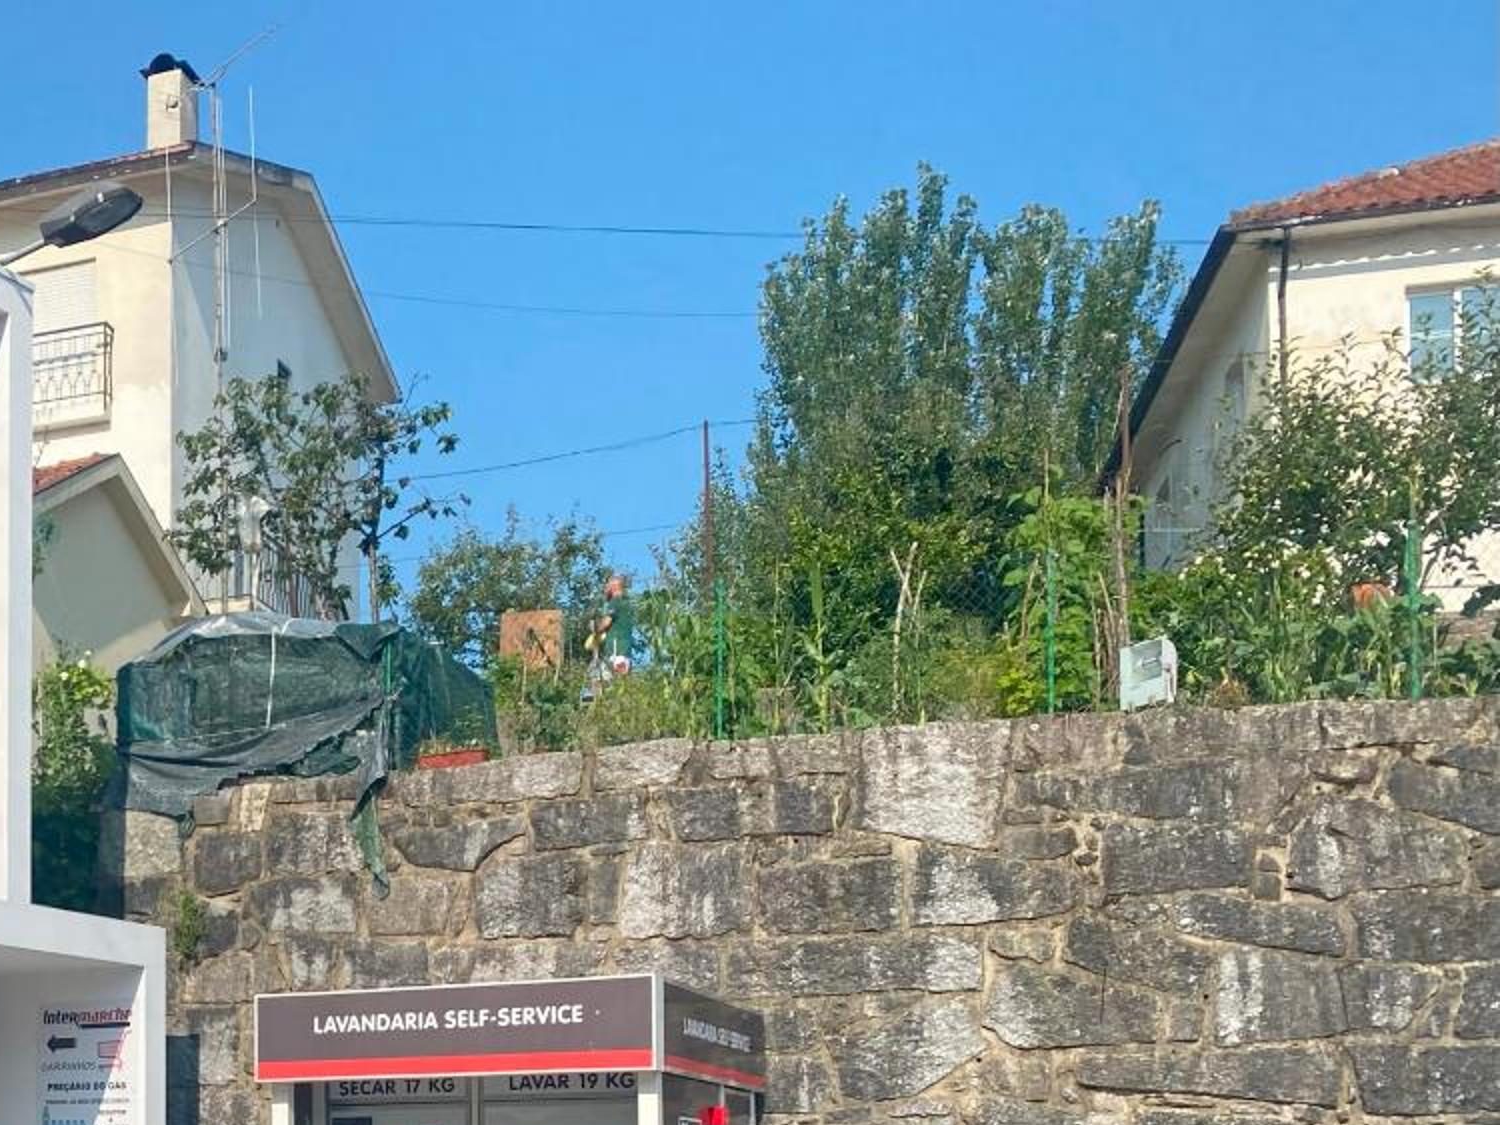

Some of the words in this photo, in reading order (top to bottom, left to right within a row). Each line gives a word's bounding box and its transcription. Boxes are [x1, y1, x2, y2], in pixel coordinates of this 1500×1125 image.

[313, 1011, 438, 1035] LAVANDARIA
[444, 1004, 583, 1029] SELF-SERVICE
[339, 1080, 396, 1097] SECAR
[404, 1079, 421, 1094] 17
[428, 1077, 455, 1094] KG
[508, 1073, 570, 1091] LAVAR
[579, 1072, 599, 1089] 19
[605, 1071, 636, 1089] KG
